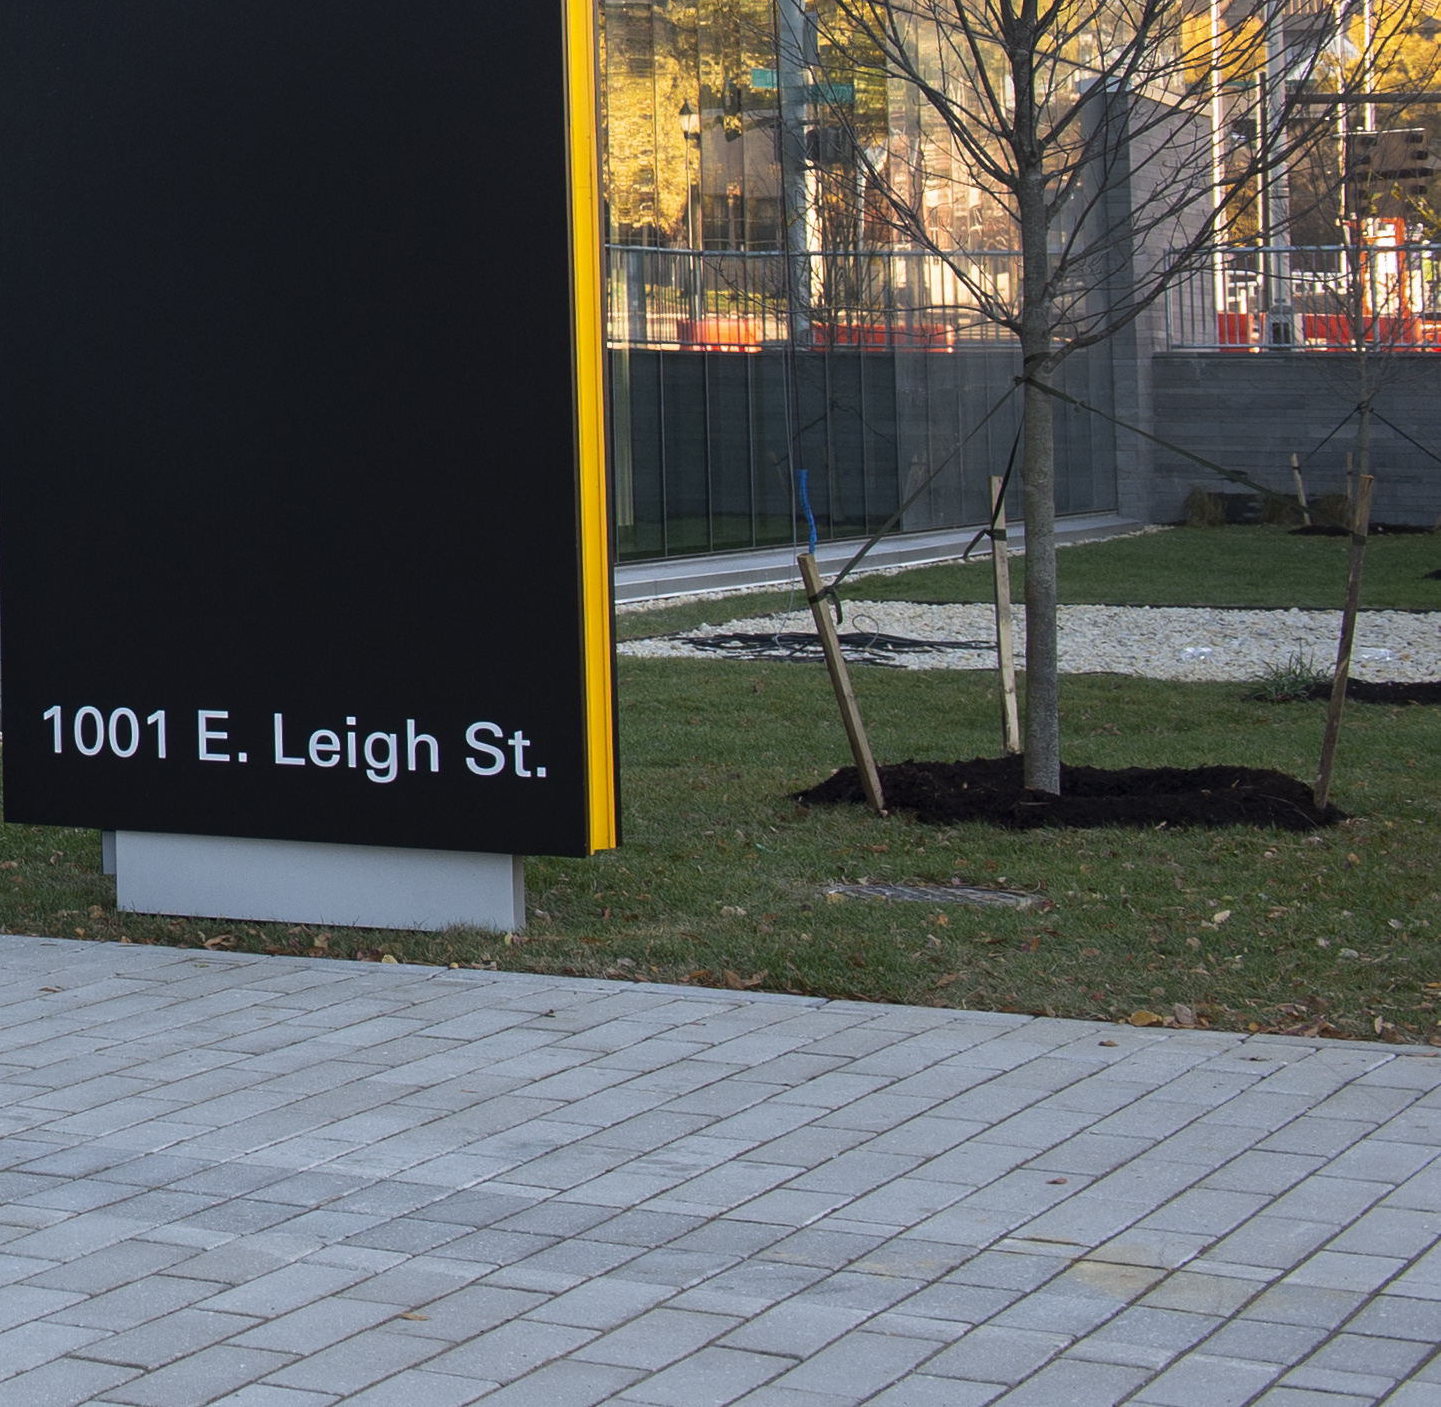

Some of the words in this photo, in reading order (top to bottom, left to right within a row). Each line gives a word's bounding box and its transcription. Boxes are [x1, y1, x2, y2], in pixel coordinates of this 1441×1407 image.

[42, 704, 168, 759] 1001
[197, 708, 249, 764] E.
[273, 711, 440, 784] Leigh
[465, 721, 548, 778] St.
